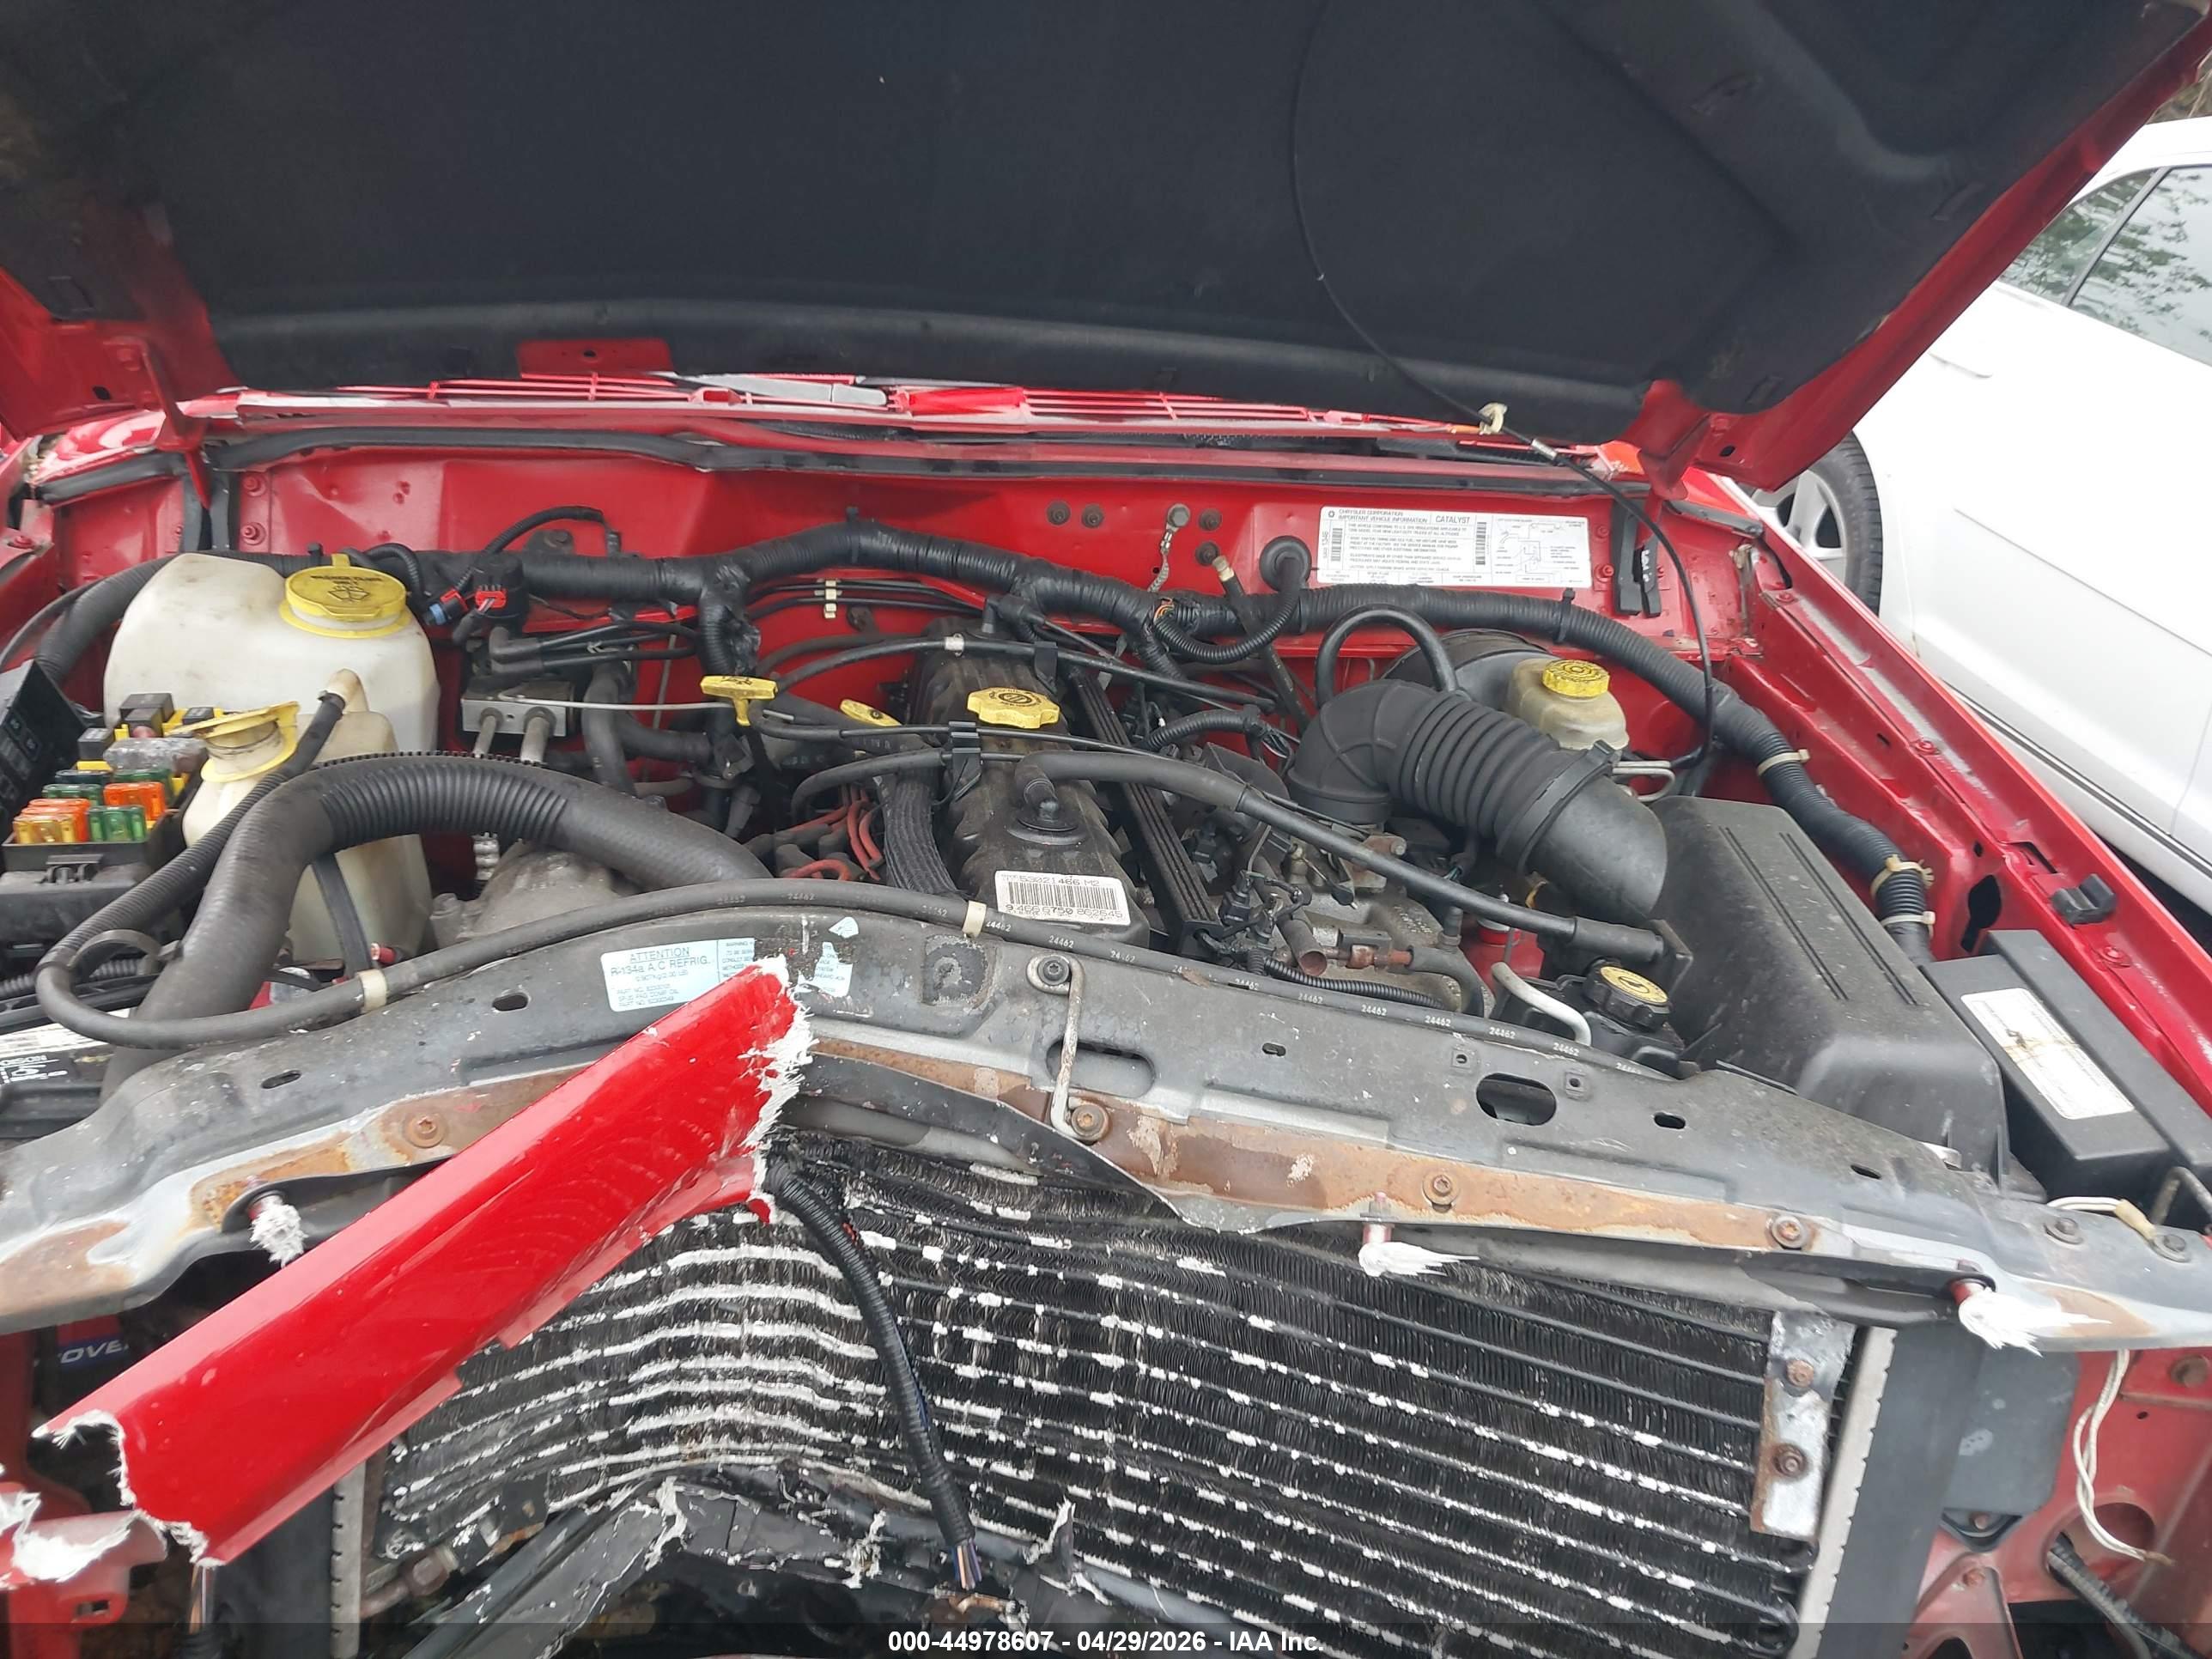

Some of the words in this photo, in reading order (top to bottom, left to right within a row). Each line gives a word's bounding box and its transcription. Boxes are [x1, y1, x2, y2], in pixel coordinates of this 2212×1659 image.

[1435, 515, 1470, 525] CATALYST
[1048, 935, 1074, 948] 24462
[629, 946, 690, 962] ATTENTION
[611, 963, 645, 976] R-134a
[669, 955, 711, 969] REFRIG.
[1297, 993, 1323, 1004] 24462
[1361, 1004, 1388, 1017] 24462
[1424, 1015, 1451, 1027] 24462
[1488, 1026, 1516, 1039] 24462
[1552, 1042, 1580, 1056] 24462
